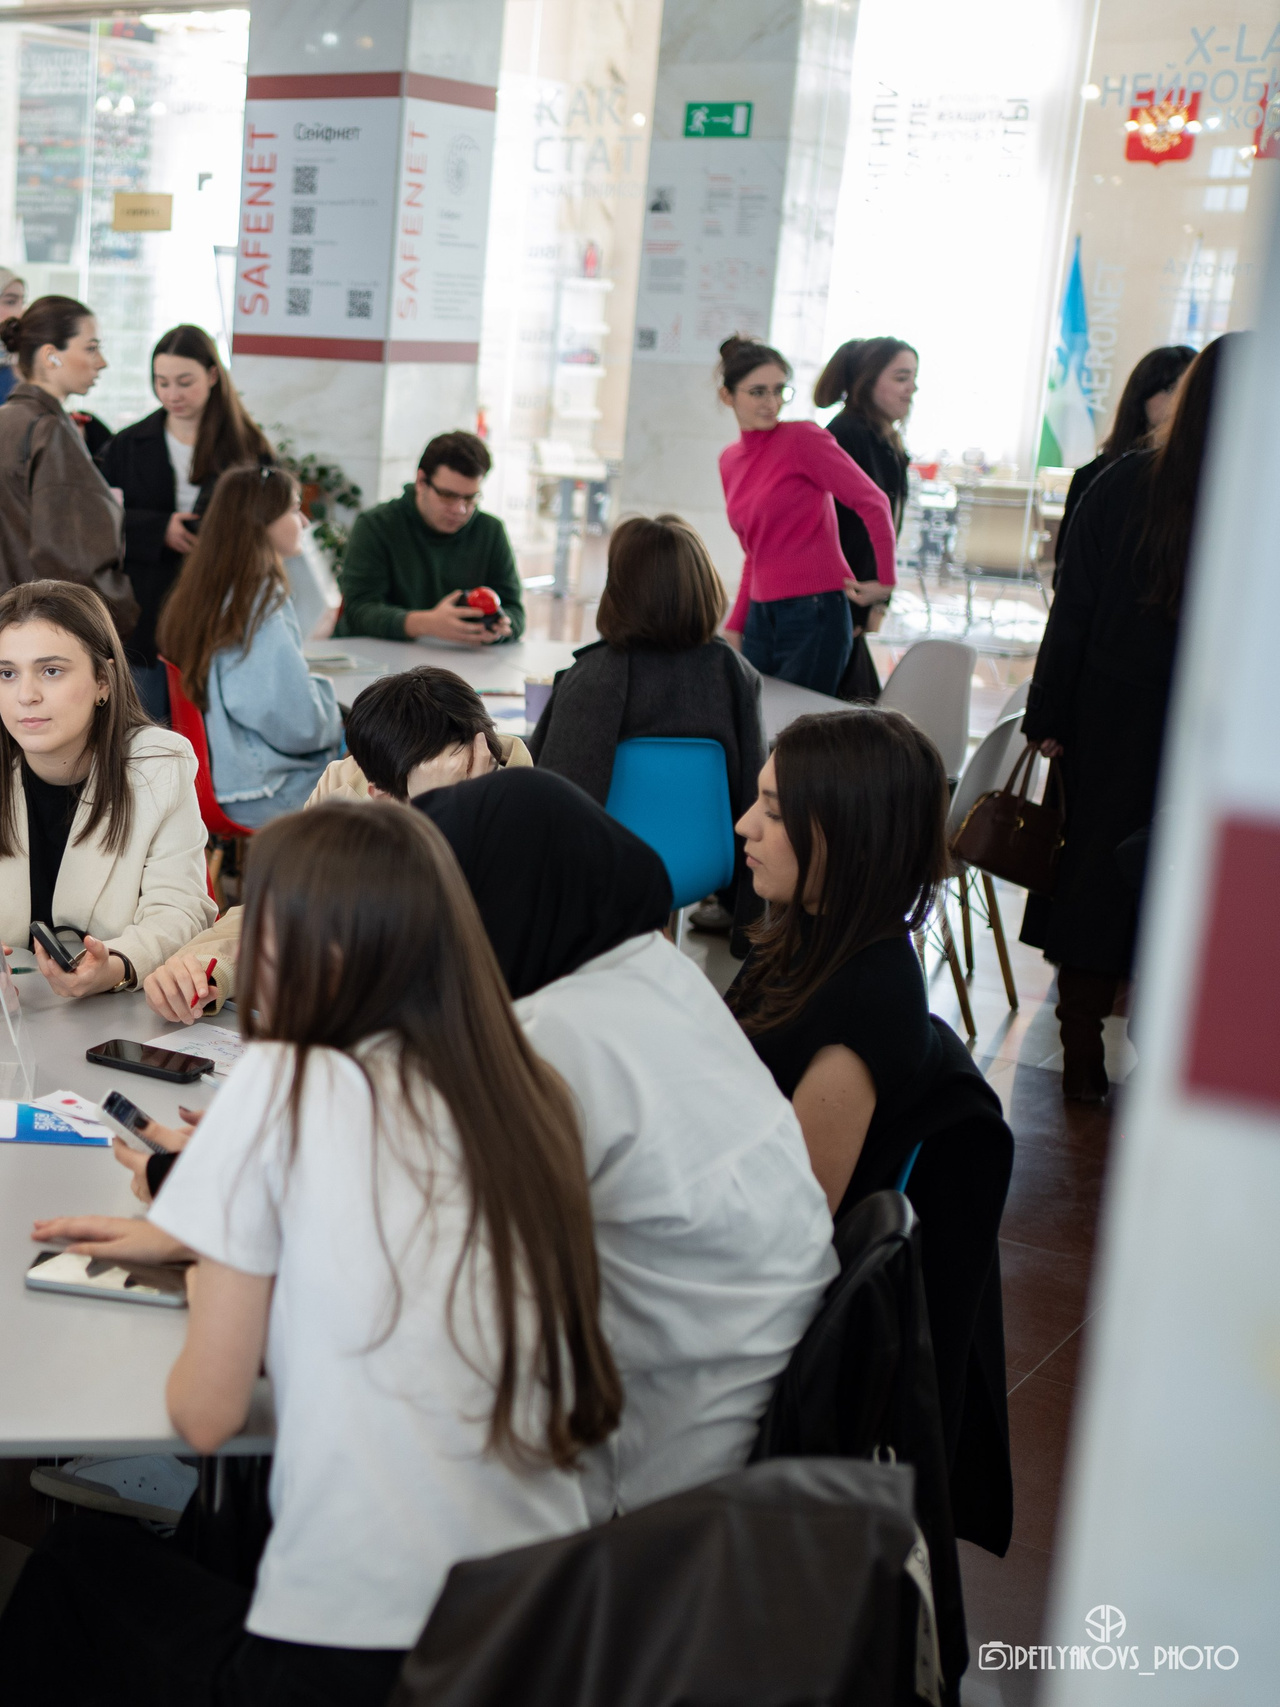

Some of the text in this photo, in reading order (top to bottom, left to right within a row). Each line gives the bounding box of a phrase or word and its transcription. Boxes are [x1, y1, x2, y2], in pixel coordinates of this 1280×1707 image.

[237, 122, 278, 317] SAFENET
[294, 121, 362, 144] Сейфнет
[397, 120, 428, 320] SAFENET
[1081, 259, 1127, 414] AERONET
